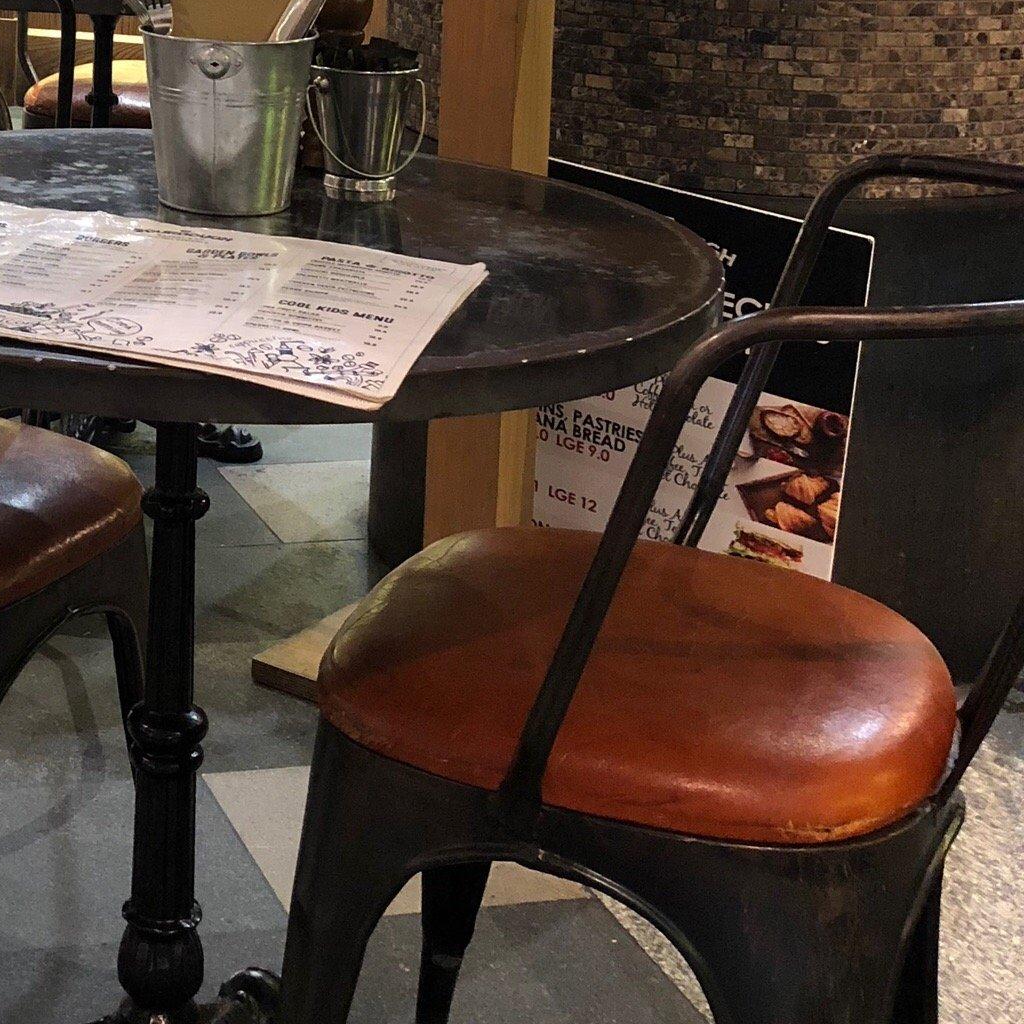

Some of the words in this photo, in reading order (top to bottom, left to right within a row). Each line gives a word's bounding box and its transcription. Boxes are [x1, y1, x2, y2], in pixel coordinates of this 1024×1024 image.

[278, 299, 312, 310] COOL
[316, 305, 350, 315] KIDS
[353, 311, 395, 324] MENU
[573, 409, 644, 444] PASTRIES
[573, 425, 626, 453] BREAD
[556, 434, 584, 454] LGE
[588, 445, 611, 462] 9.0
[548, 485, 576, 506] LGE
[581, 496, 598, 513] 12
